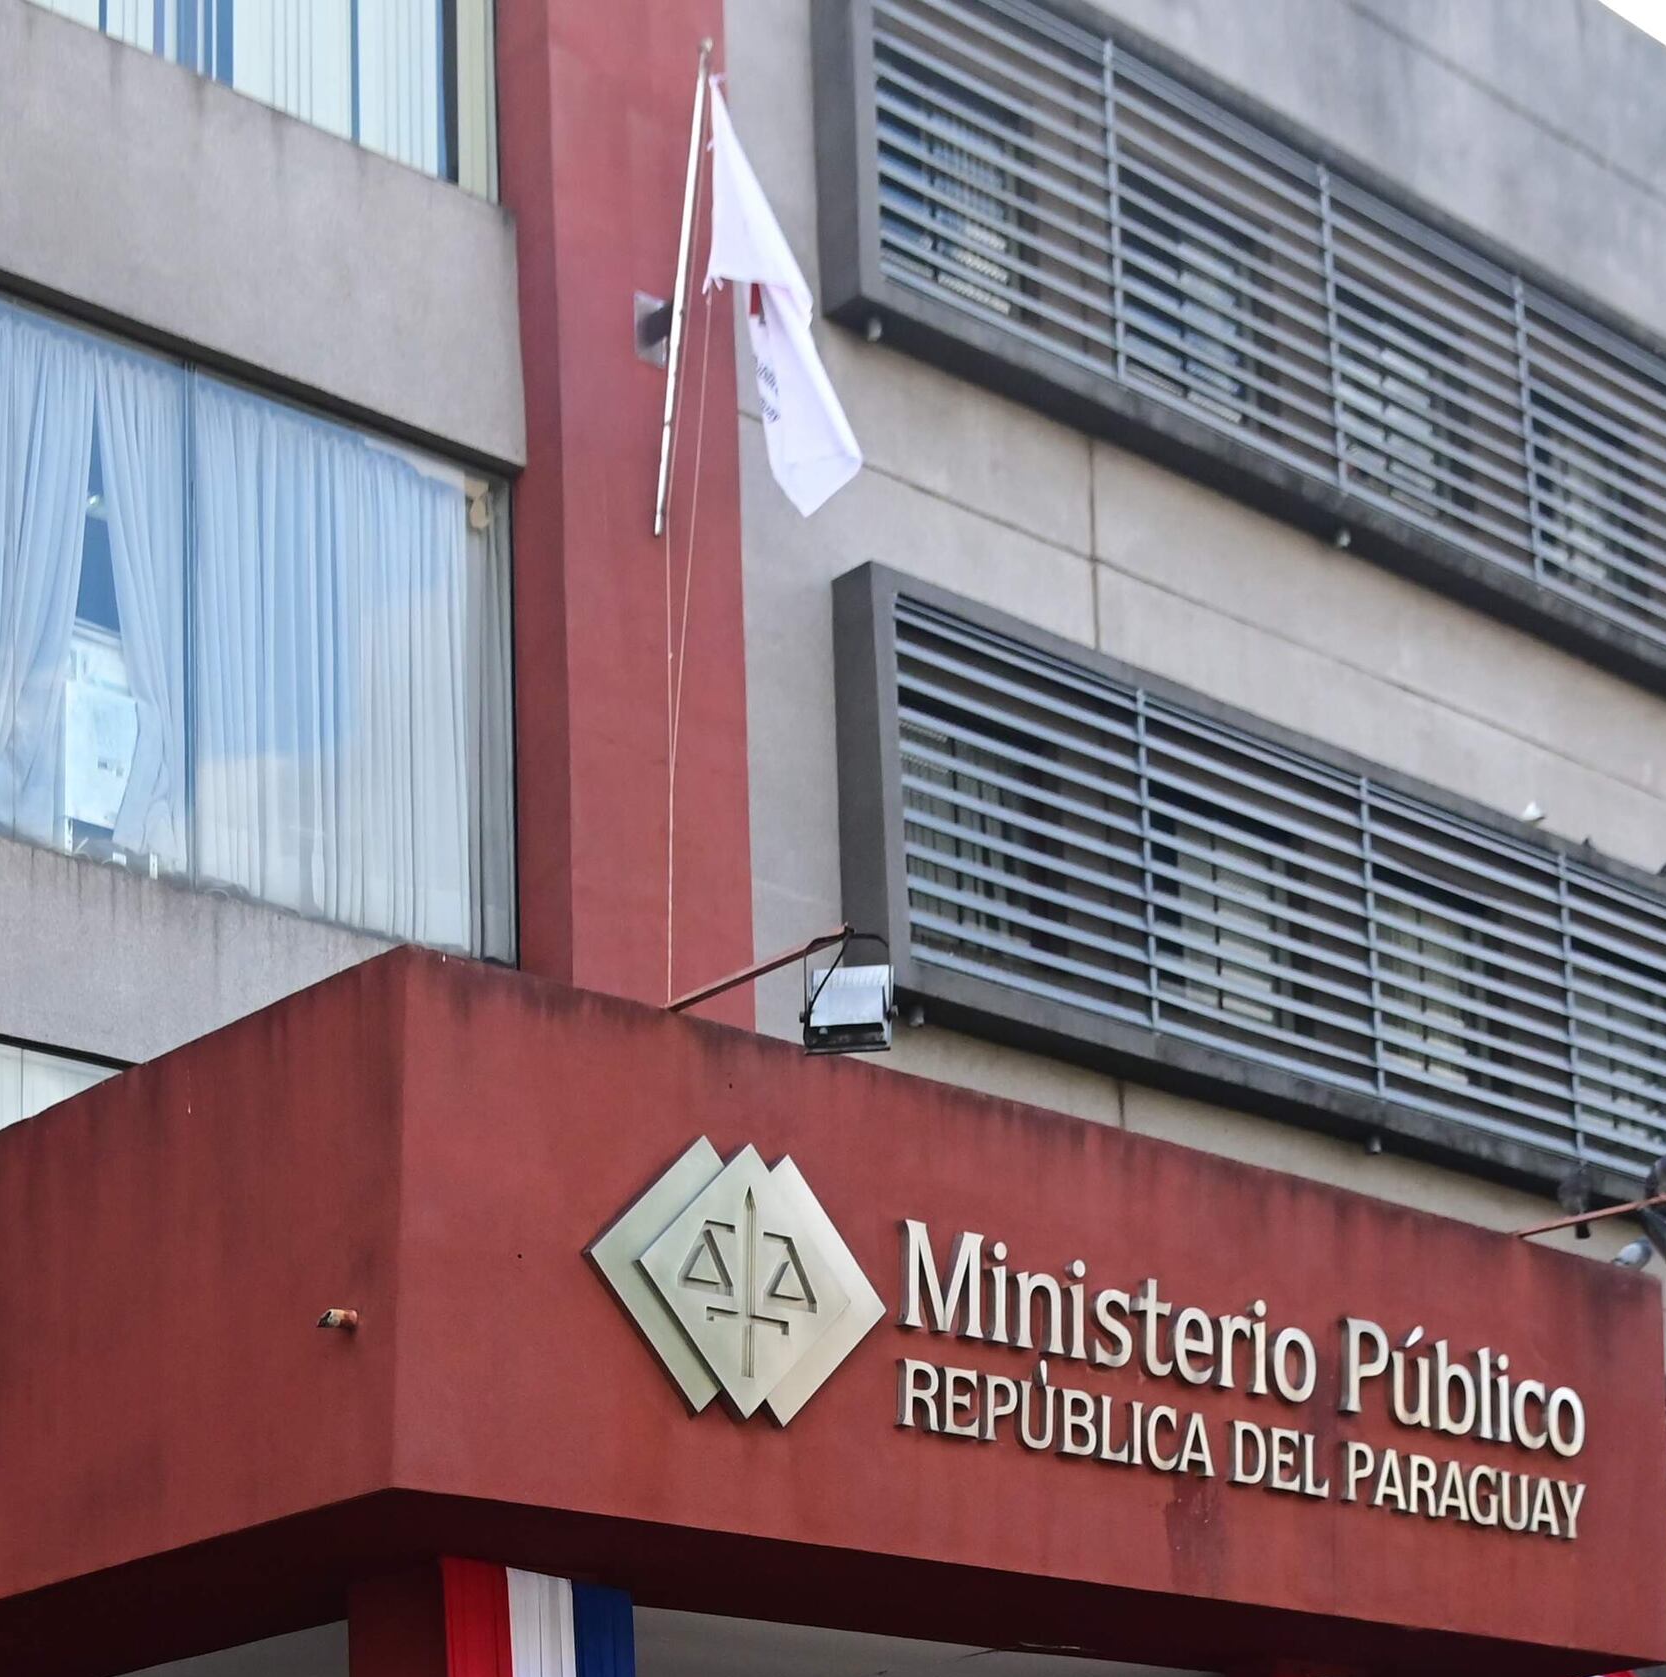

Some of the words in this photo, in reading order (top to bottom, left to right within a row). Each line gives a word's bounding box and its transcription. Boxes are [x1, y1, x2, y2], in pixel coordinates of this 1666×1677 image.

[899, 1218, 1316, 1403] Ministerio
[1339, 1316, 1585, 1458] Público
[898, 1357, 1215, 1478] REPÚBLICA
[1230, 1419, 1330, 1499] DEL
[1343, 1440, 1586, 1540] PARAGUAY
